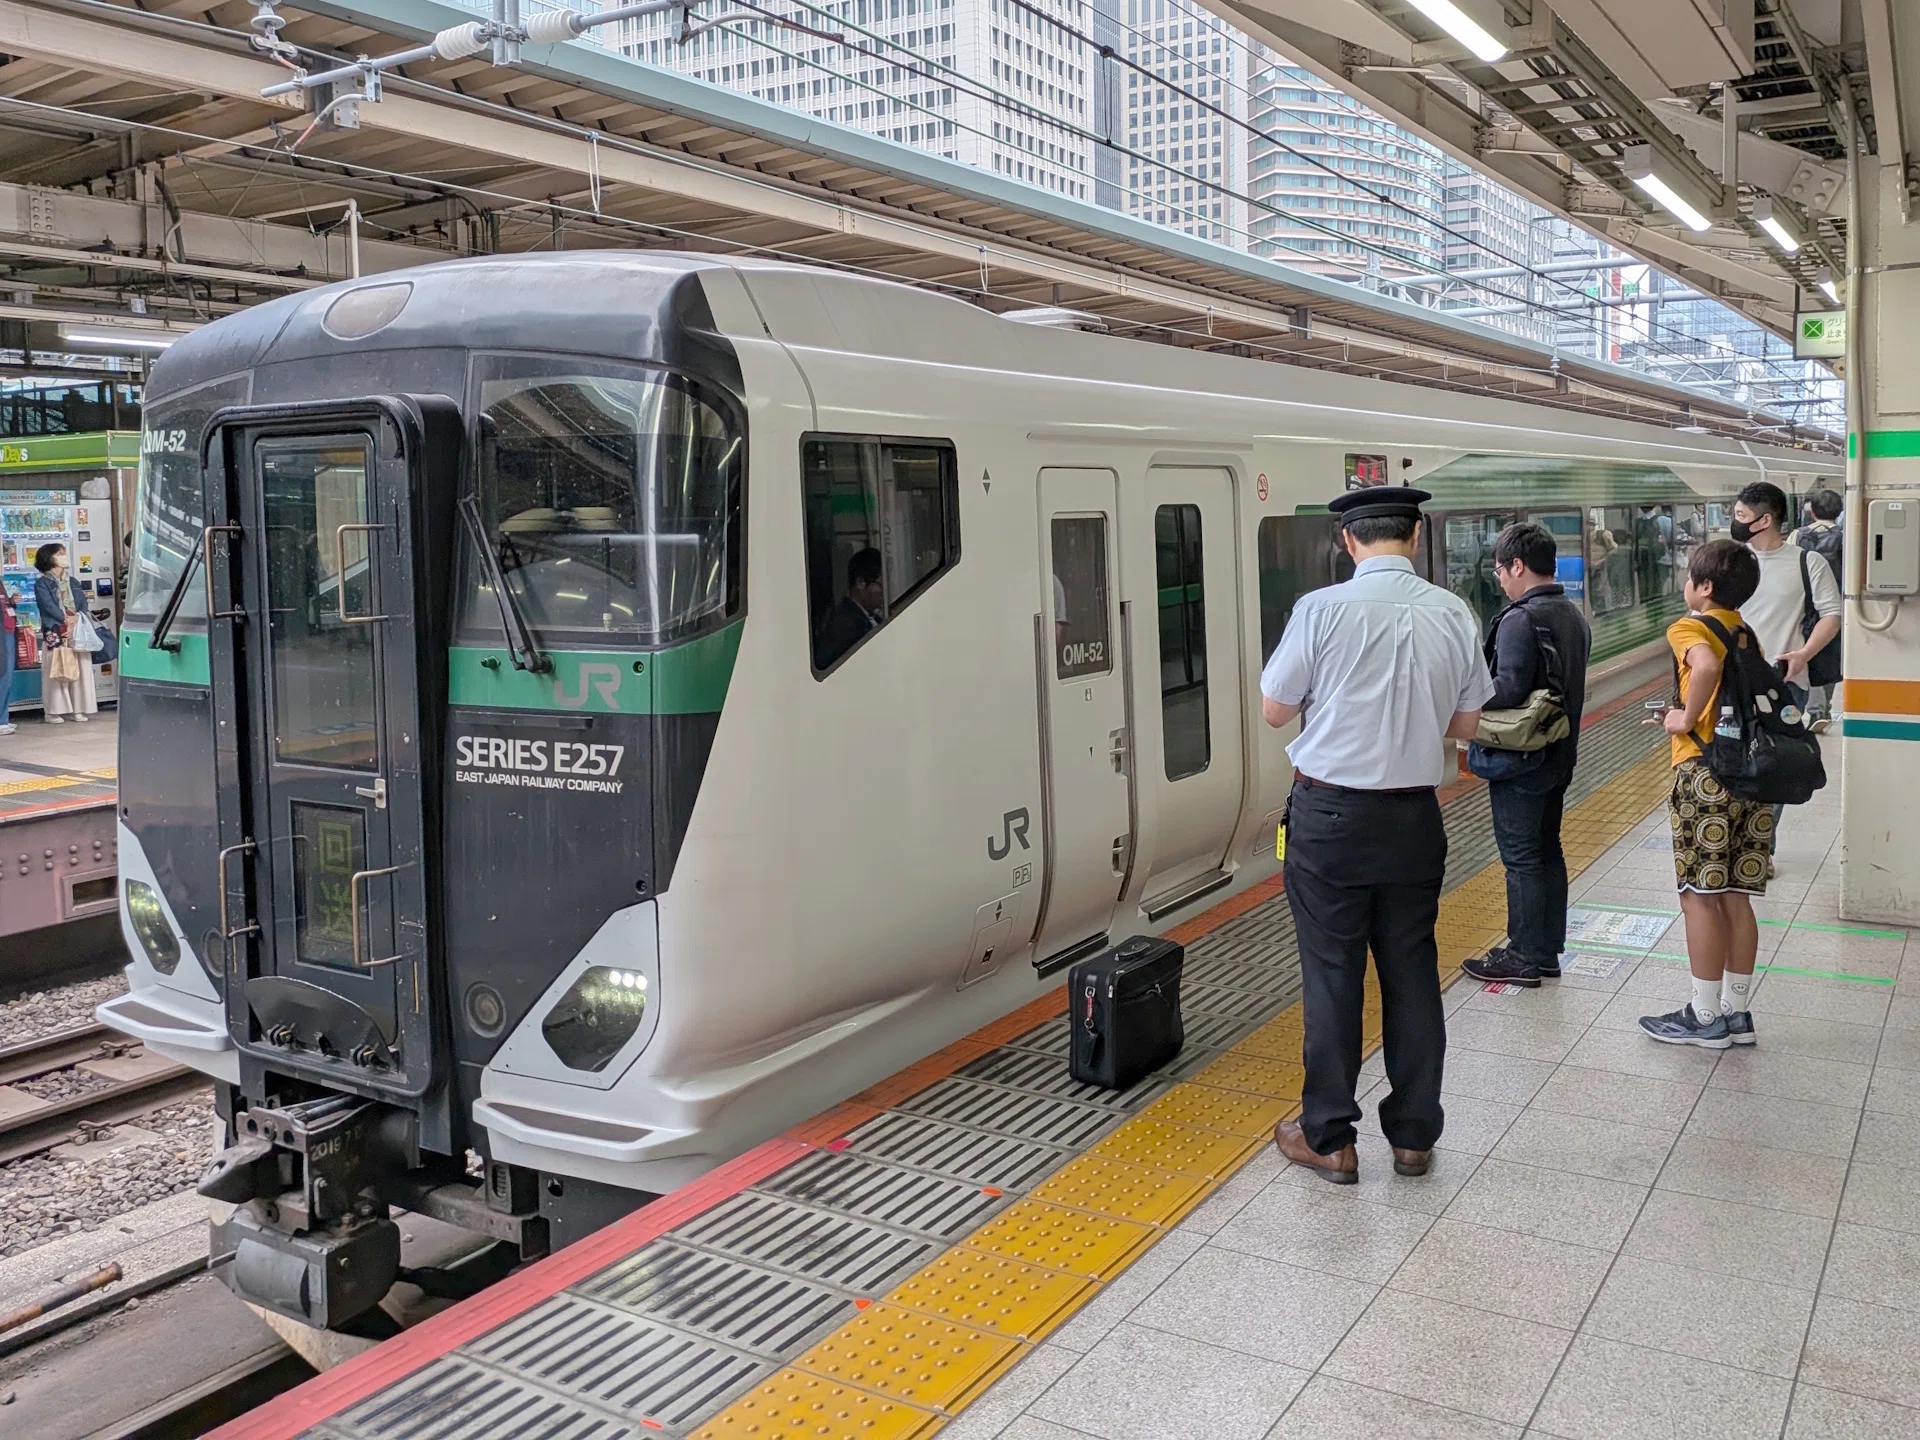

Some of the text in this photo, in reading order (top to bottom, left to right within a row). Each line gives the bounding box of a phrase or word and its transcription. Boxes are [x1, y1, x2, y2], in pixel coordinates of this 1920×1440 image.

[1827, 318, 1846, 327] グリ
[142, 429, 187, 454] OM-52
[1062, 641, 1104, 667] OM-52
[553, 662, 622, 710] JR
[455, 735, 625, 777] SERIES E257
[455, 771, 624, 794] EAST JAPAN RAILWAY COMPANY
[987, 806, 1031, 861] JR
